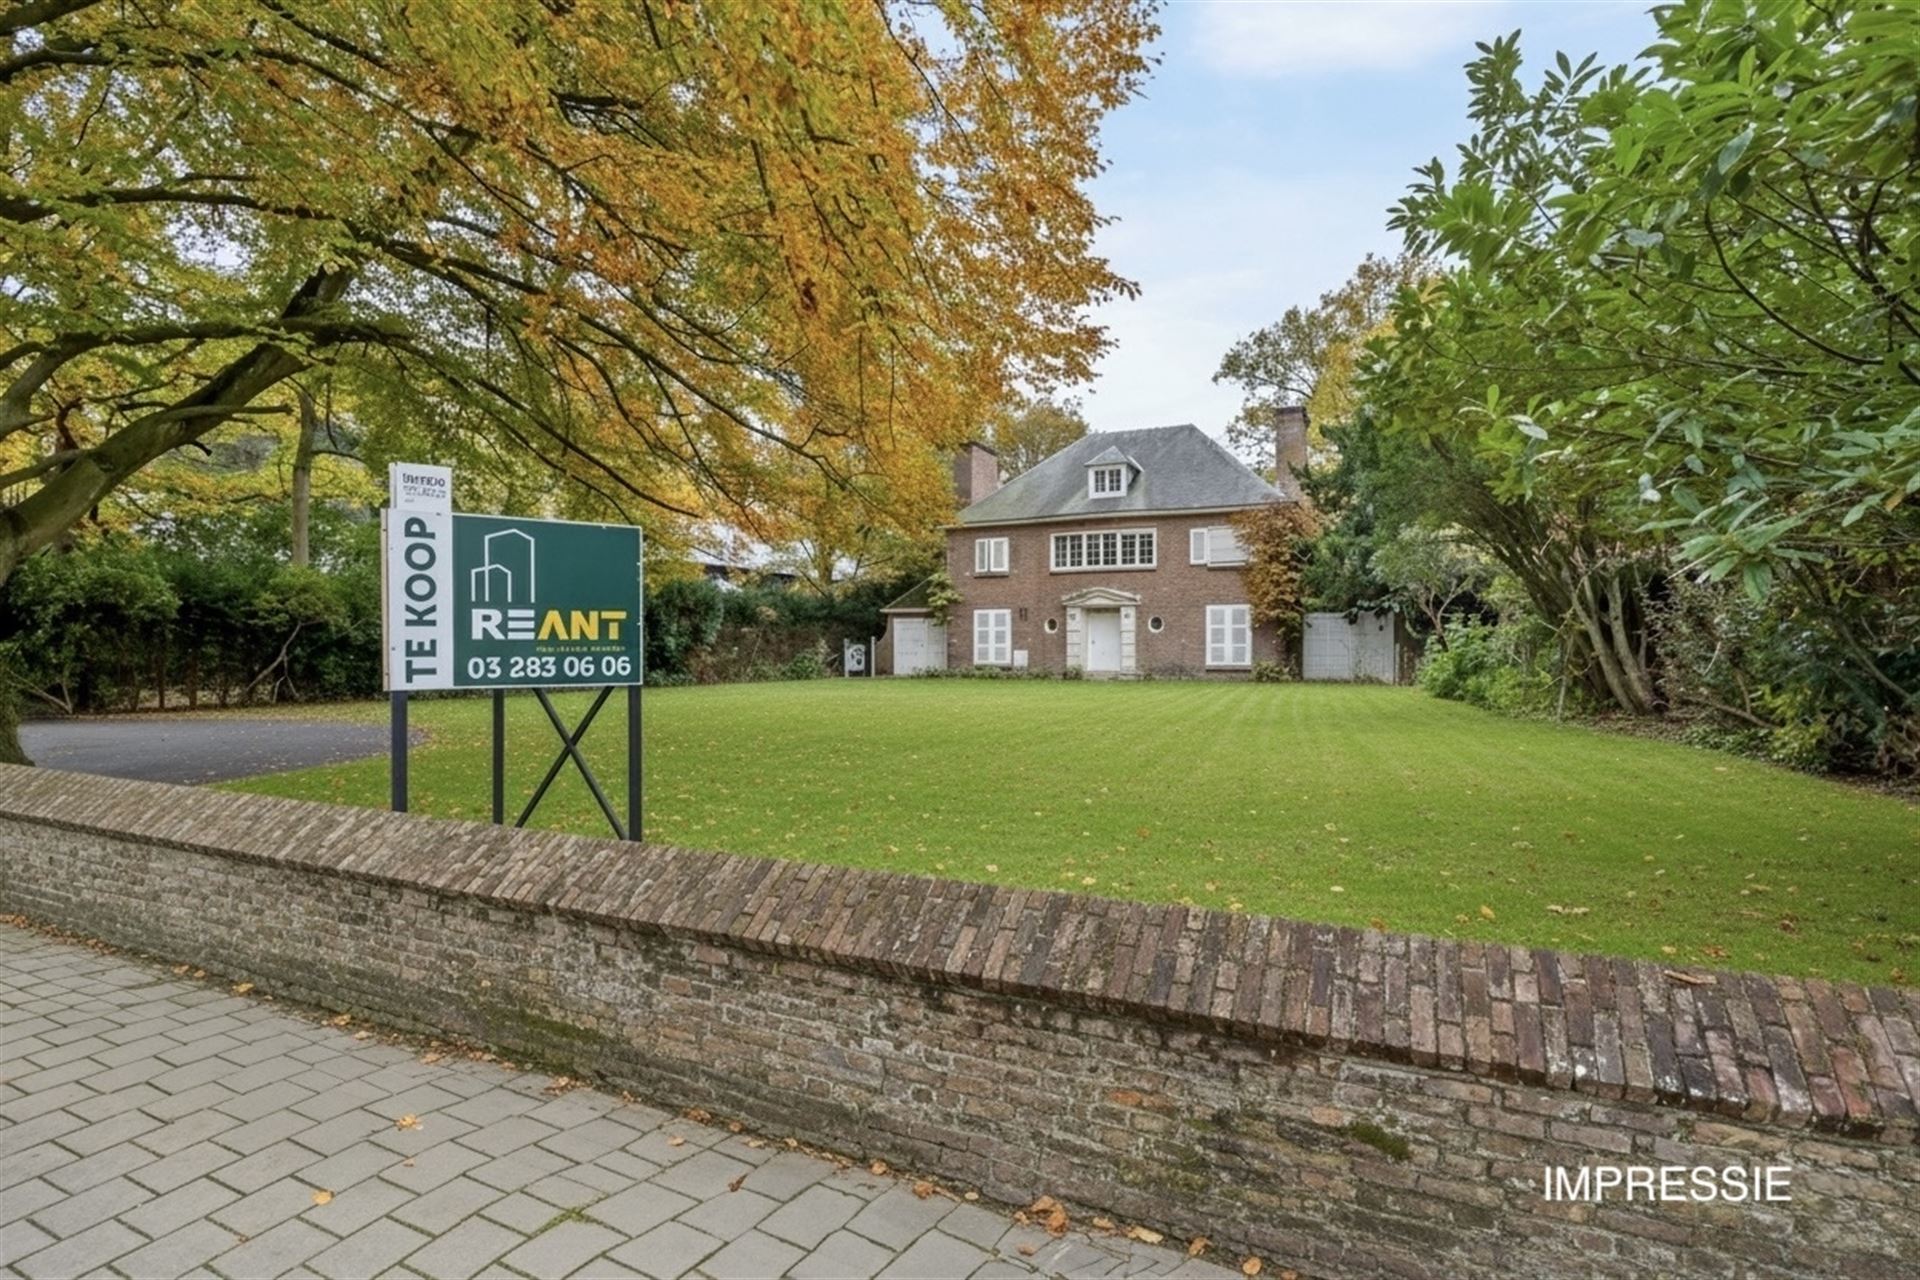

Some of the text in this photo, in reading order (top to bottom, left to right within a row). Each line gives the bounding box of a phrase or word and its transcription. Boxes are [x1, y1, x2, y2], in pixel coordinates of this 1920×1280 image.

[404, 516, 438, 627] KOOP
[471, 608, 627, 640] REANT
[405, 638, 438, 683] TE
[467, 655, 632, 679] 03 283 06 06
